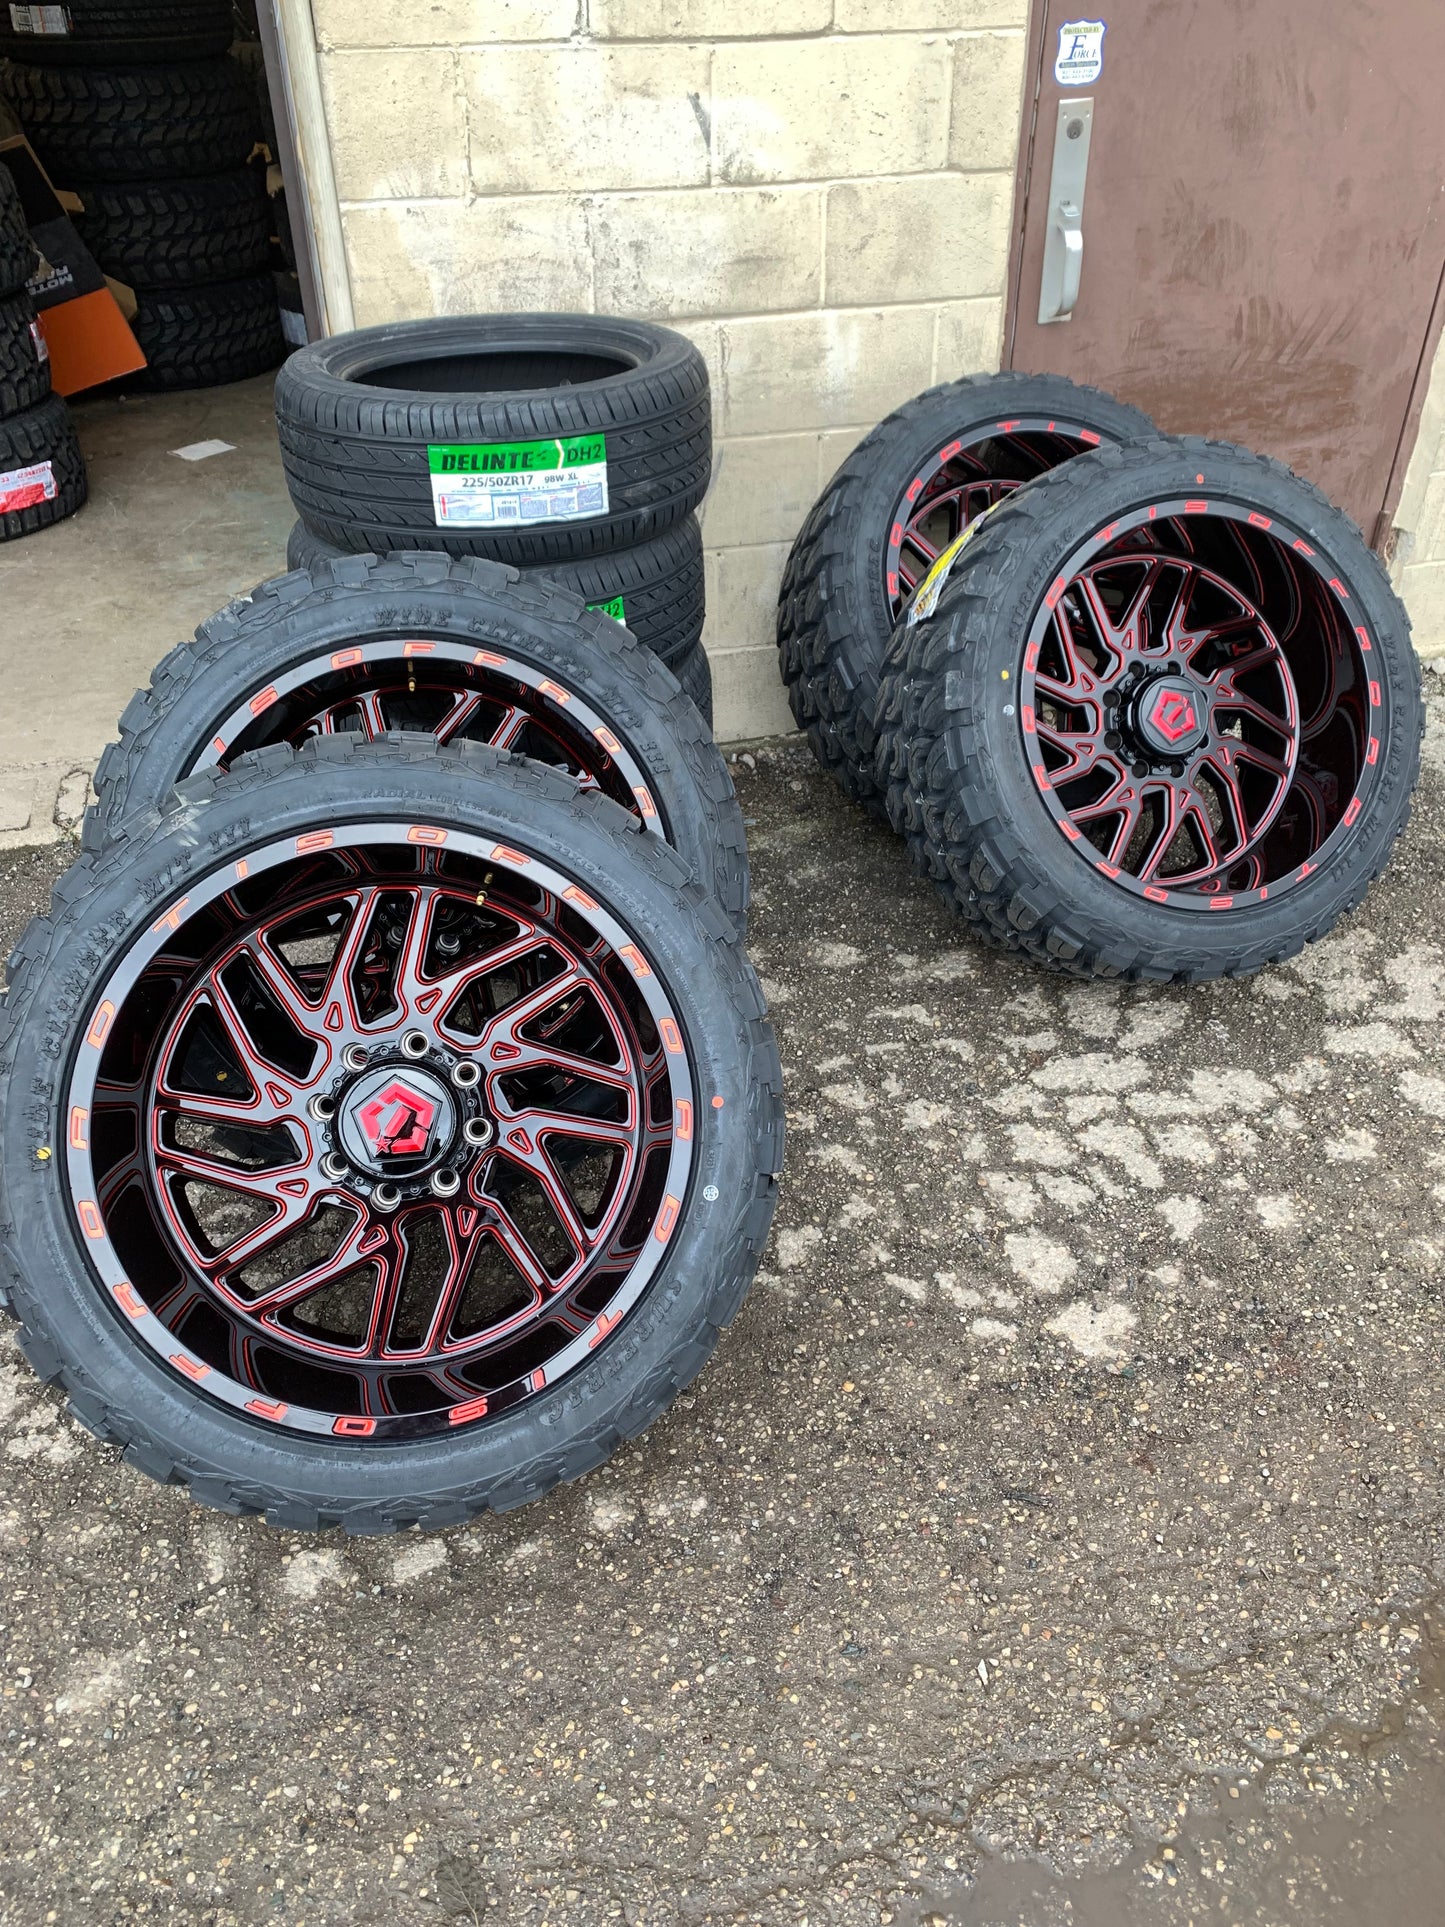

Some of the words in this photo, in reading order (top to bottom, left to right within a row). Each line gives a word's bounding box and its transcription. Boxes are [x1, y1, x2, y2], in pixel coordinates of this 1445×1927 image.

[442, 451, 534, 471] DELINTE
[567, 444, 602, 462] DH2
[461, 475, 534, 488] 225/50ZR17
[544, 475, 565, 484] 98W
[568, 472, 579, 481] XL
[1095, 499, 1209, 543] TIS
[375, 606, 453, 628] WIDE
[467, 615, 592, 685] CLIMBER
[152, 828, 335, 935] TIS
[1209, 862, 1319, 910] TIS
[29, 1076, 54, 1172] WIDE
[47, 908, 132, 1060] CLIMBER
[136, 853, 193, 905] M/T
[447, 1310, 624, 1427] TIS
[547, 1278, 684, 1425] SURETRAC
